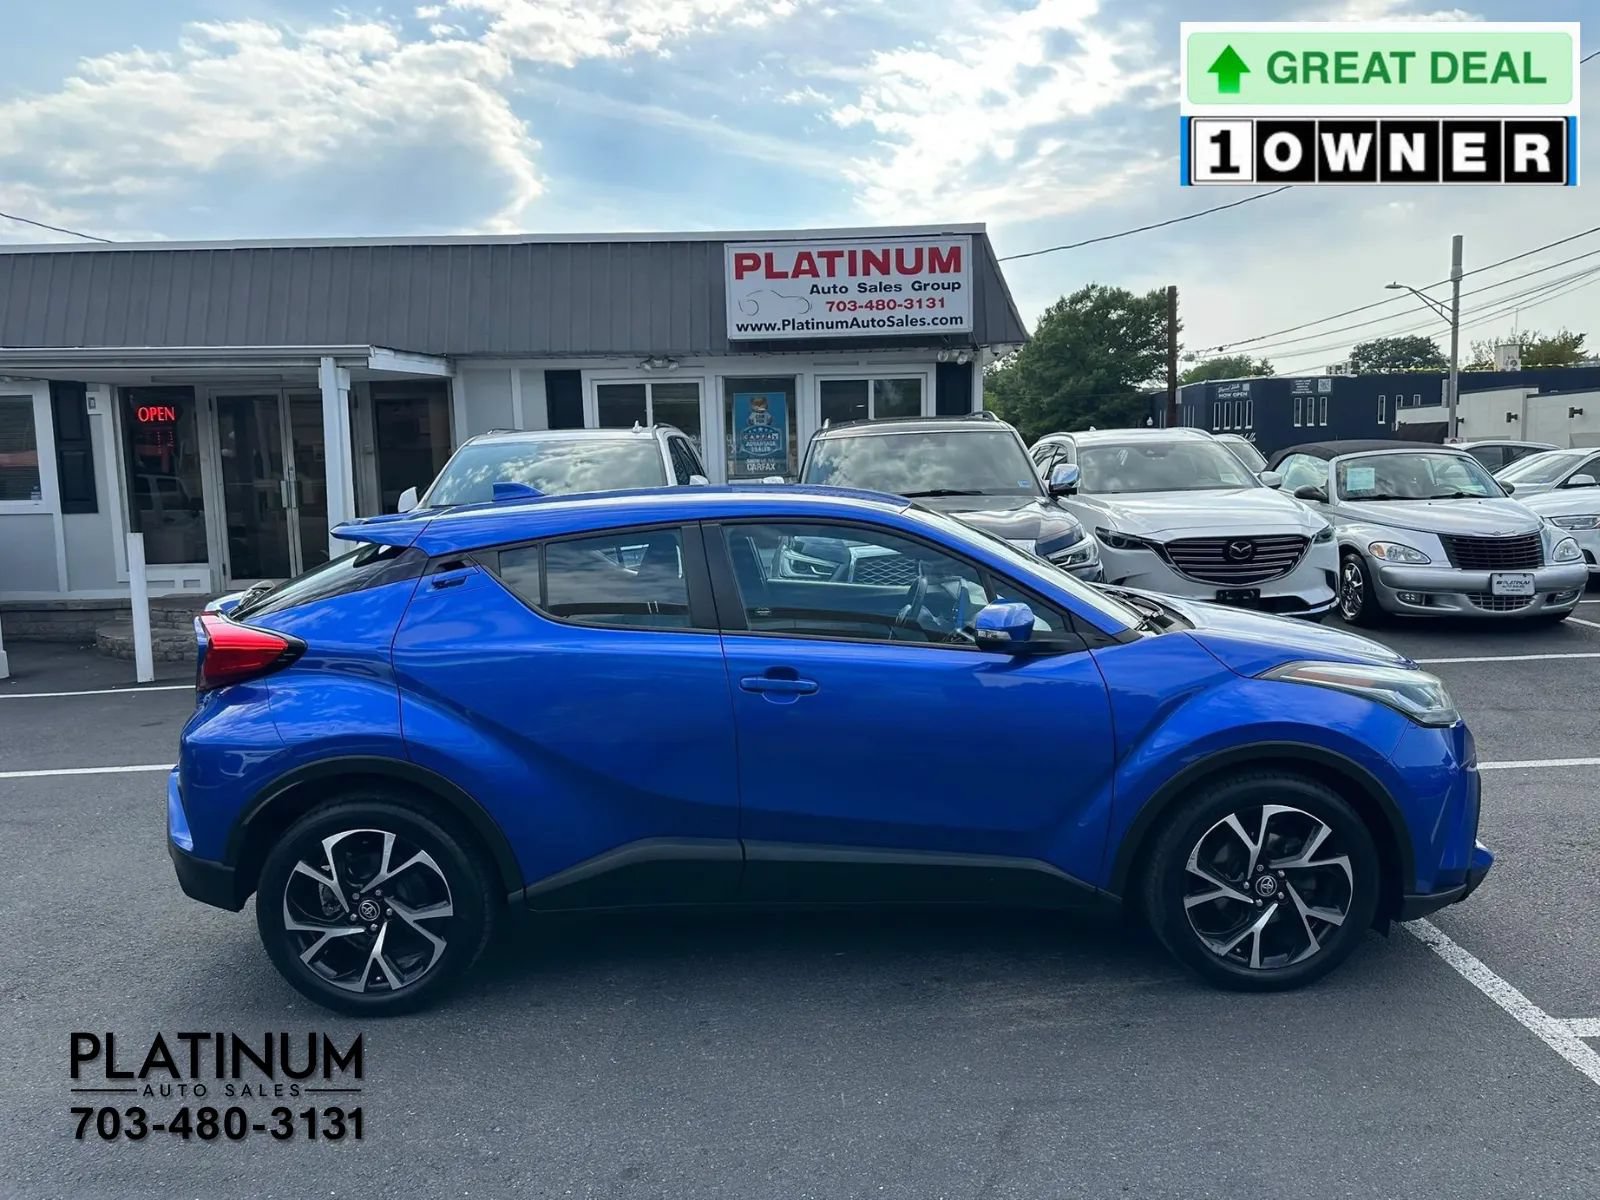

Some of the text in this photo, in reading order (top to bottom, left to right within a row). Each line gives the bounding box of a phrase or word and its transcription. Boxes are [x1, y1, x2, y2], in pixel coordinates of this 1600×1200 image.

[734, 246, 962, 280] PLATINUM
[809, 279, 962, 296] Auto Sales Group
[825, 297, 946, 312] 703-480-3131
[735, 314, 964, 333] www.PlatinumAutoSales.com
[137, 406, 175, 422] OPEN
[746, 463, 776, 472] CARFAX
